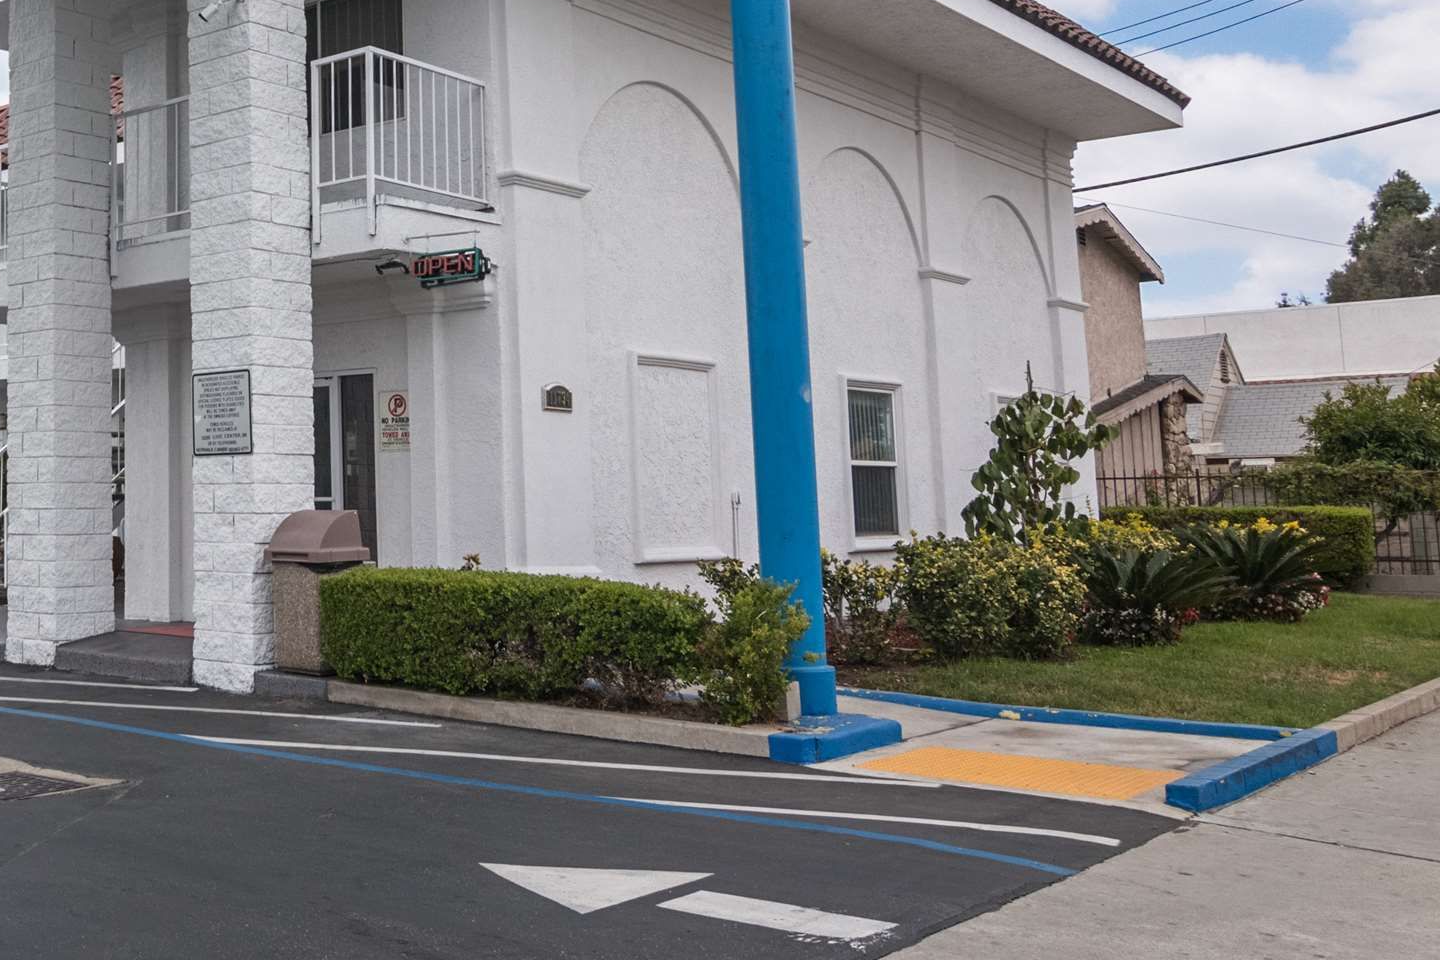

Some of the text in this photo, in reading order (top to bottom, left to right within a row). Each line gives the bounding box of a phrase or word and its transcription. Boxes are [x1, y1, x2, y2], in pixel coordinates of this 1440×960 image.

[412, 253, 474, 277] OPEN
[381, 416, 410, 424] NO PARKIN
